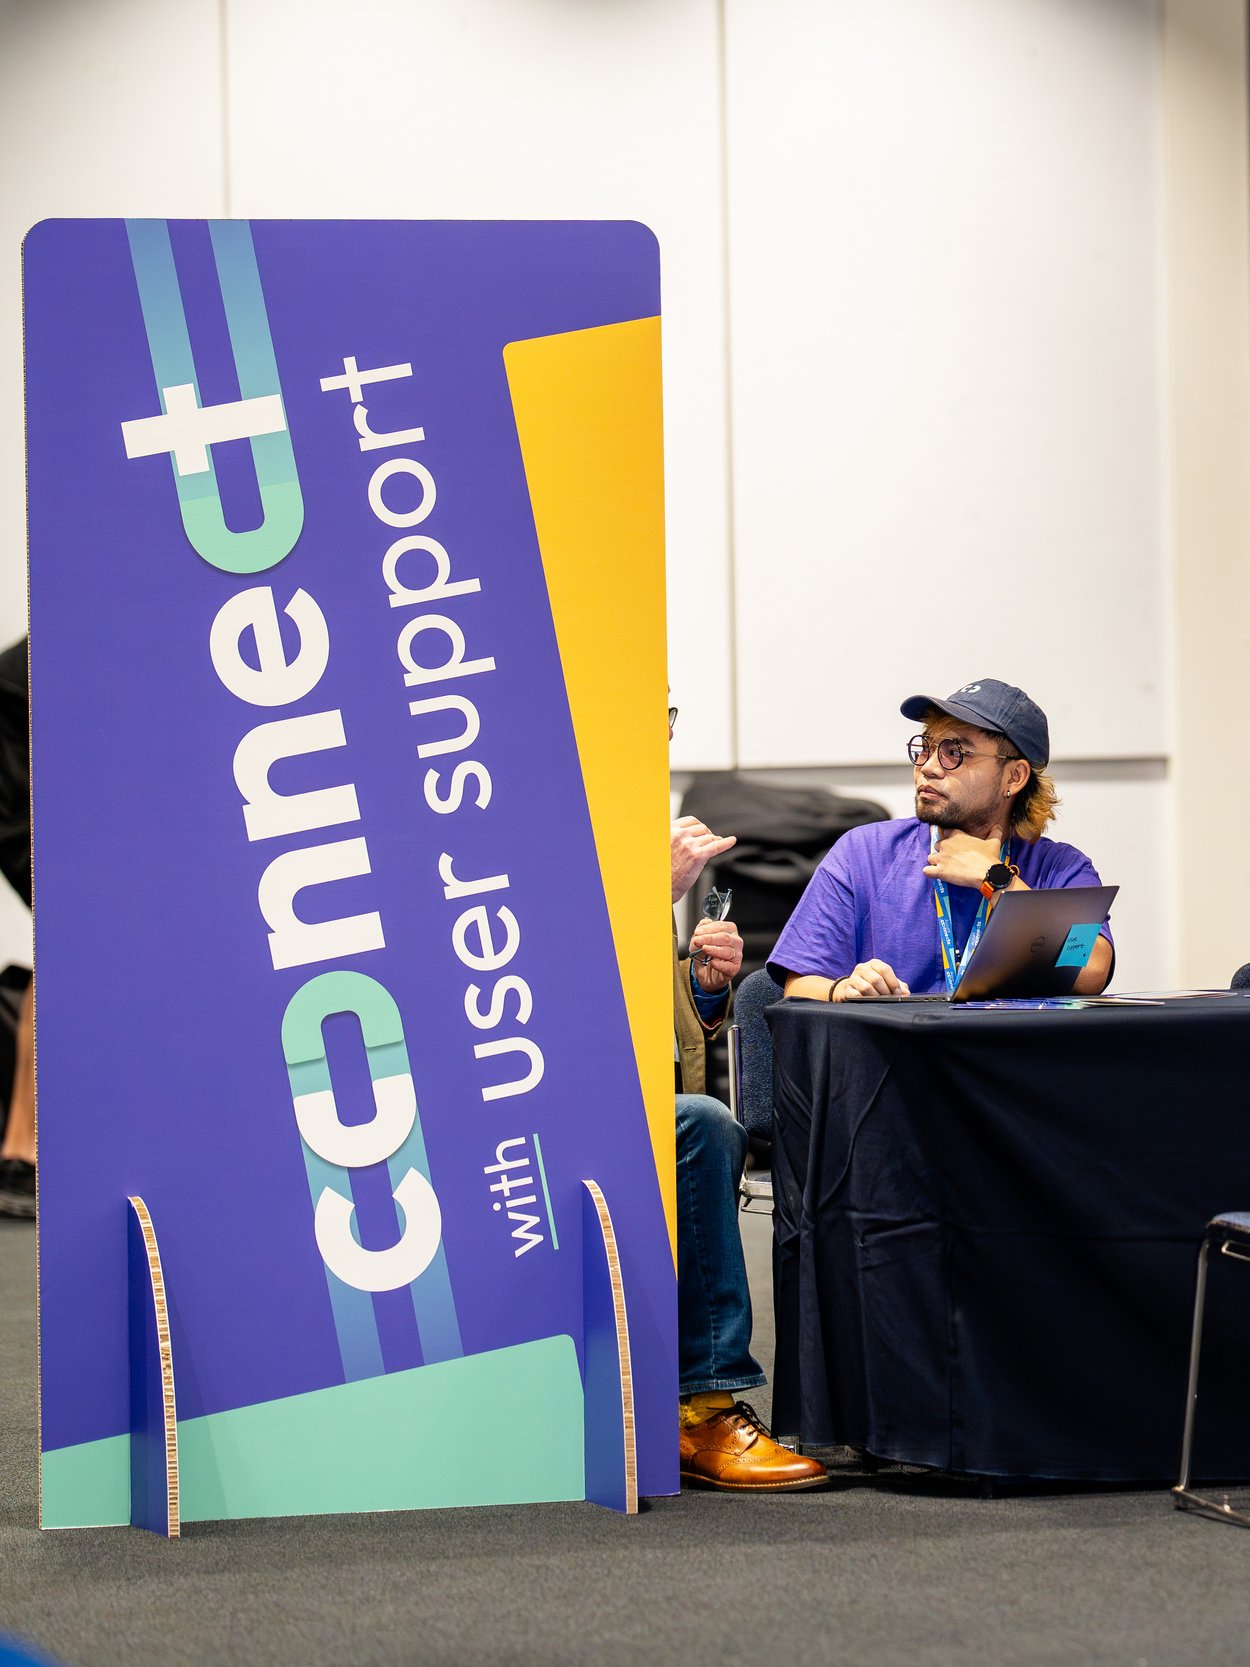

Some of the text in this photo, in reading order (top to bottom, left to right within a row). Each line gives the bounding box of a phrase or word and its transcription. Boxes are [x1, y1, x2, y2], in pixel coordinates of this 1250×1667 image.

[319, 356, 545, 1258] with user support
